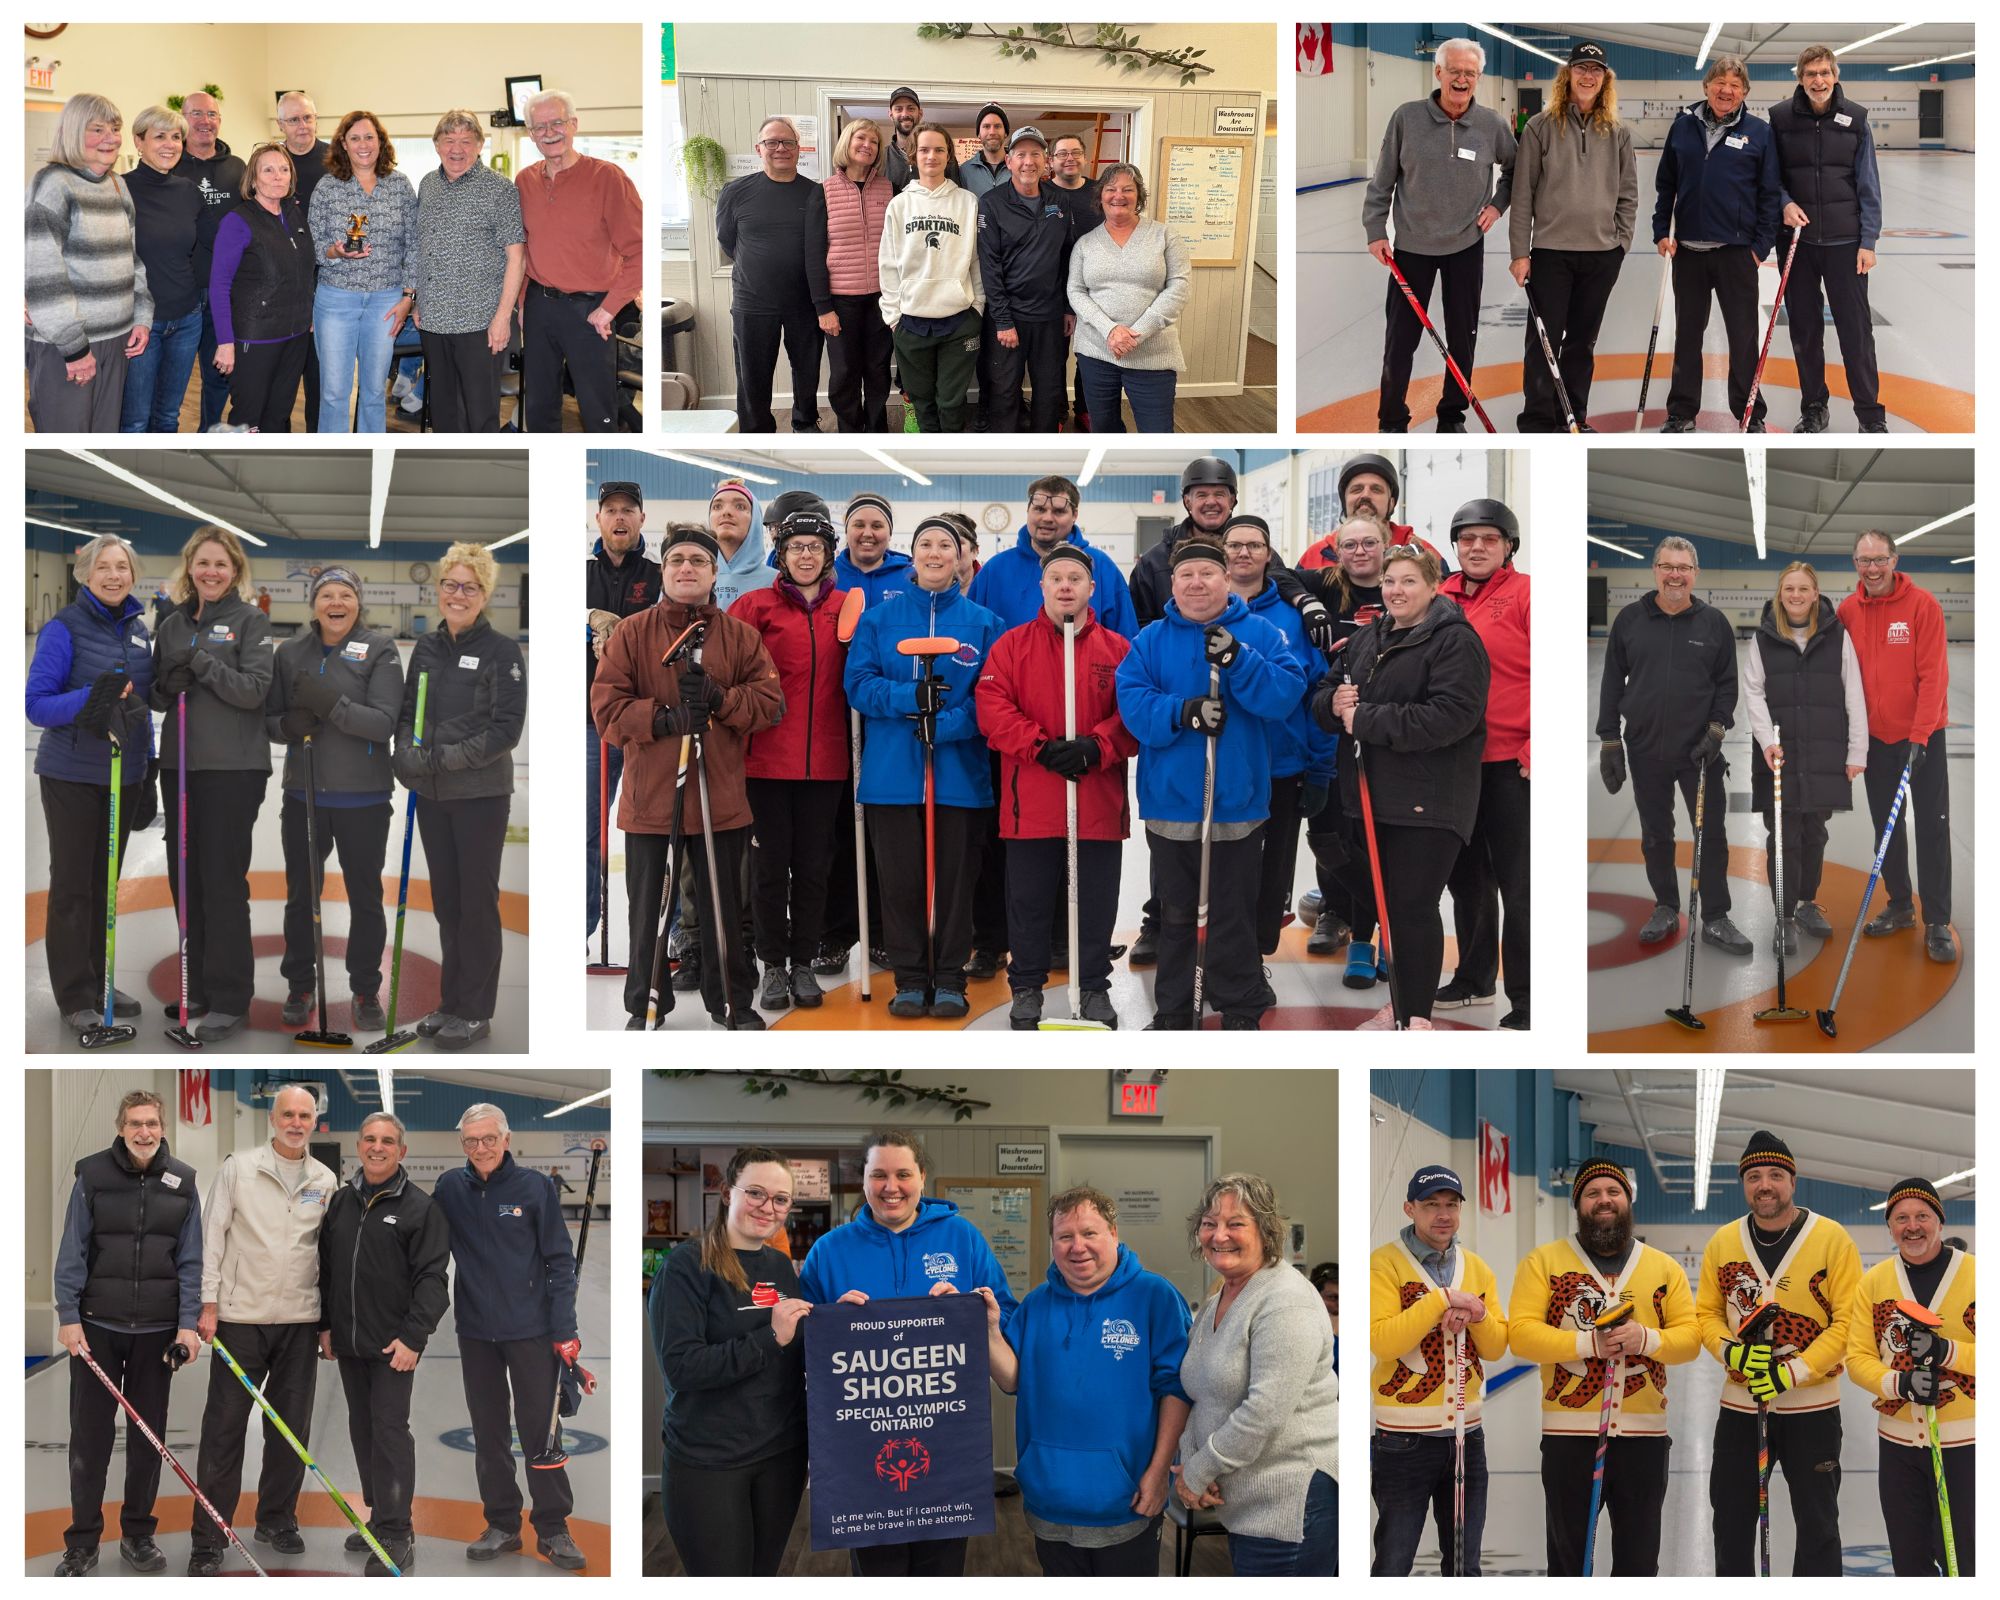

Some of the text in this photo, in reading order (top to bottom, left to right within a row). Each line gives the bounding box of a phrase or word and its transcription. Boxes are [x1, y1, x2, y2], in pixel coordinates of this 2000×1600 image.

[30, 69, 53, 88] EXIT
[906, 220, 960, 235] SPARTANS
[1870, 830, 1892, 876] FIBERLITE
[1193, 966, 1203, 1012] Goldline
[1122, 1084, 1159, 1113] EXIT
[926, 1266, 958, 1274] CYCLONES
[850, 1317, 945, 1331] PROUD SUPPORTER
[893, 1332, 903, 1341] of
[1101, 1336, 1139, 1344] CYCLONES
[832, 1343, 966, 1374] SAUGEEN
[844, 1371, 957, 1401] SHORES
[1457, 1341, 1467, 1412] BalancePlus
[836, 1400, 966, 1421] SPECIAL OLYMPICS
[870, 1416, 934, 1432] ONTARIO
[136, 1419, 176, 1468] FIBERLITE
[832, 1514, 846, 1524] Let
[849, 1513, 864, 1521] me
[866, 1510, 885, 1519] win.
[888, 1509, 904, 1518] But
[906, 1507, 913, 1516] if
[921, 1504, 952, 1515] cannot
[954, 1502, 973, 1511] win,
[832, 1513, 975, 1535] let me be brave in the attempt.
